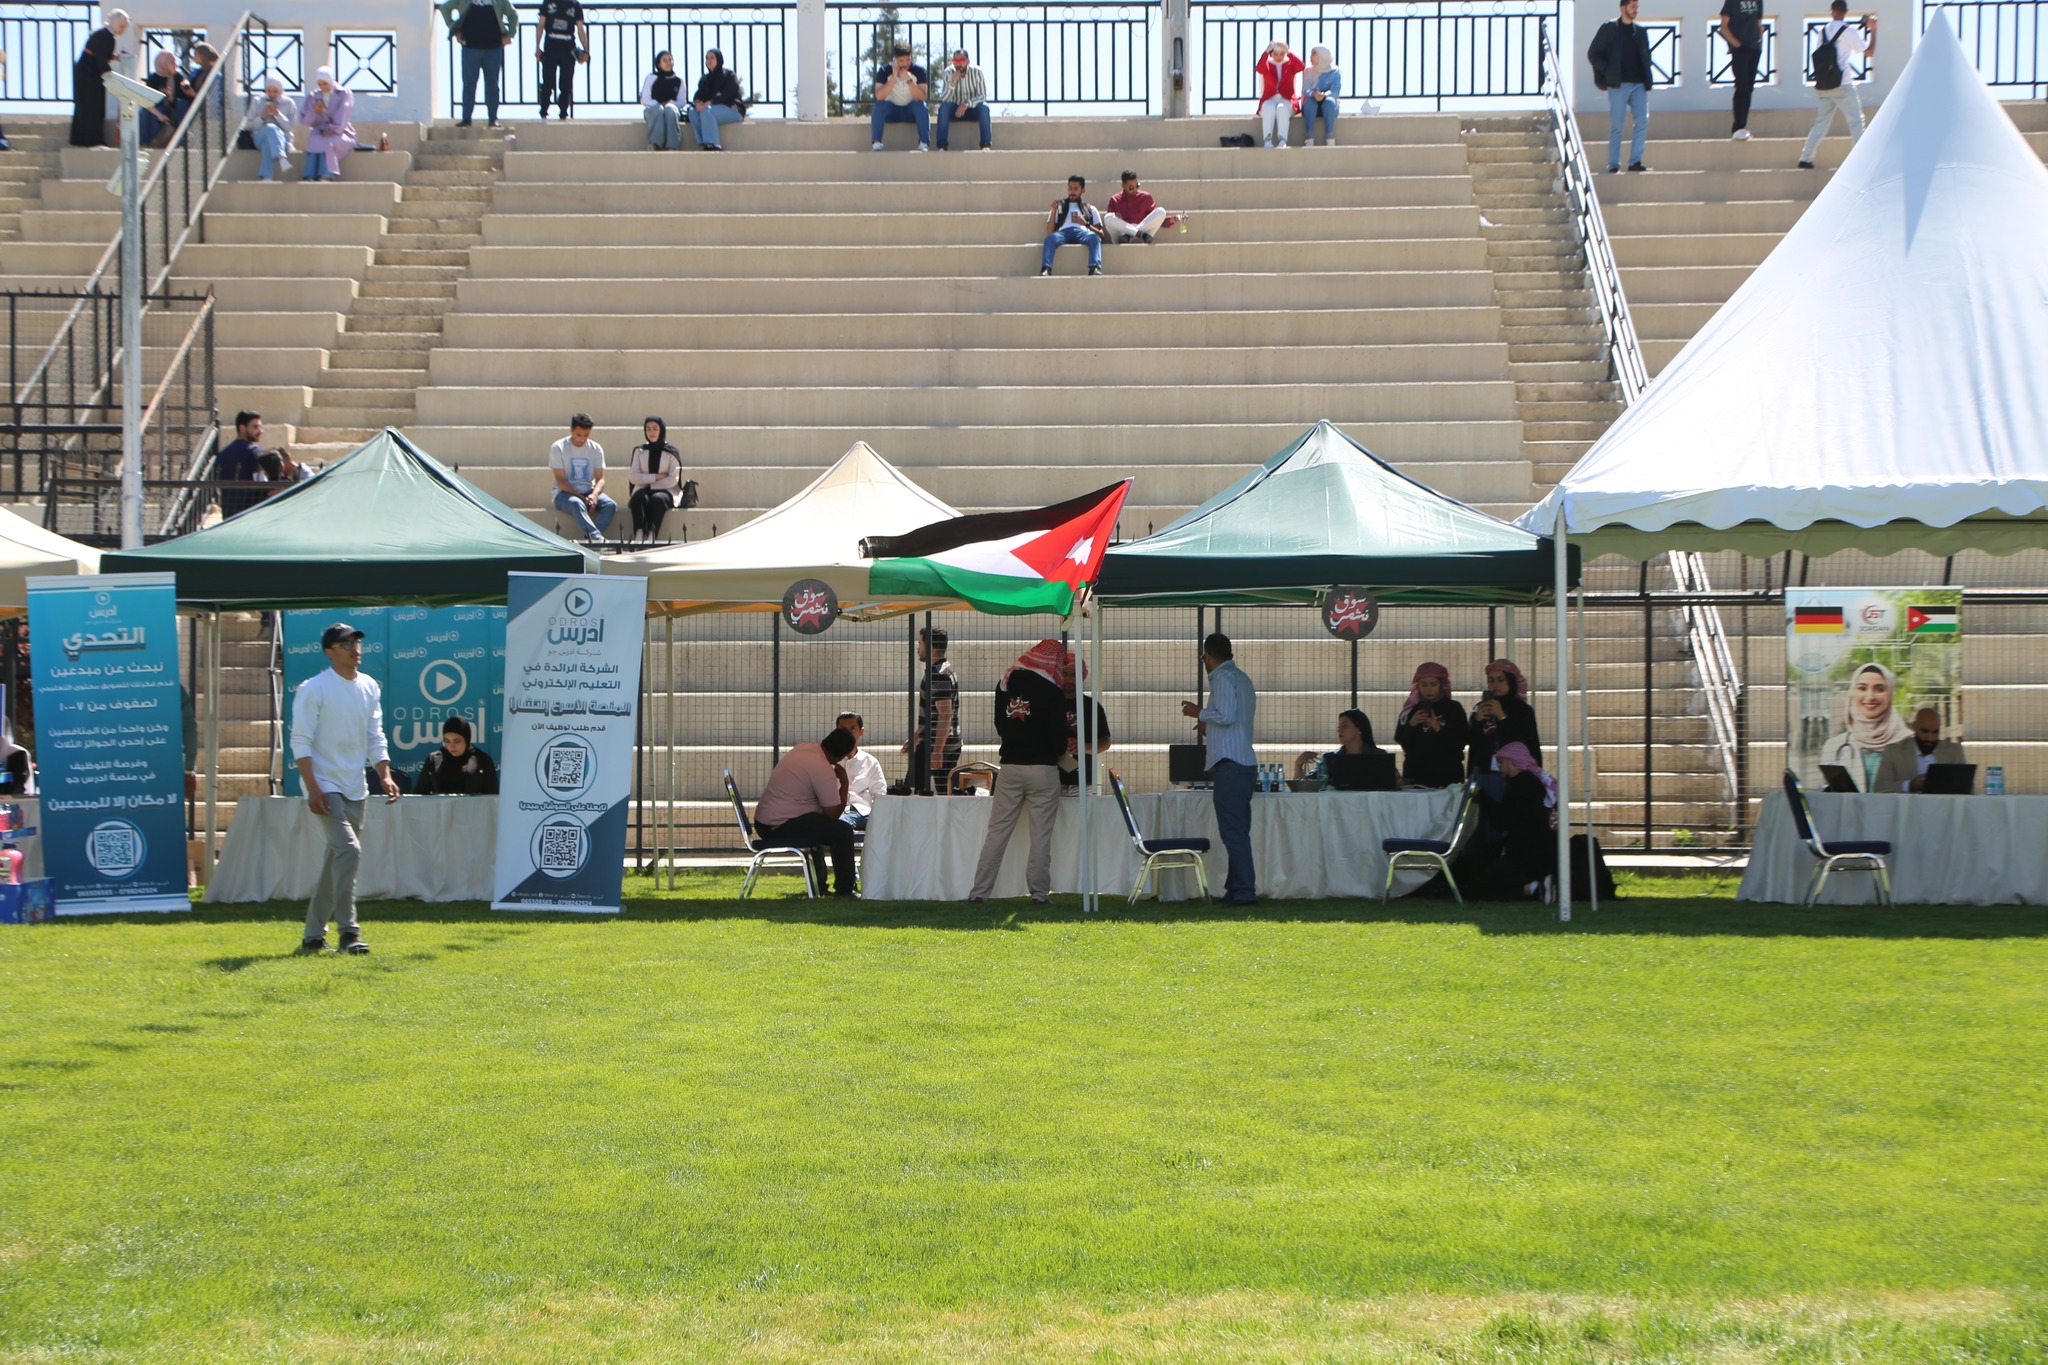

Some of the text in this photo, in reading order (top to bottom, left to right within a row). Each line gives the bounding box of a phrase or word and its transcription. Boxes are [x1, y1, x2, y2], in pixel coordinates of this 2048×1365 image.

[794, 589, 825, 609] سوق
[1334, 595, 1367, 614] سوق
[548, 616, 598, 627] ODROS
[62, 627, 146, 656] التحدي
[576, 648, 601, 657] شركة
[50, 661, 164, 678] نبحث عن مبدعين
[523, 663, 618, 675] الشركة الرائدة في
[522, 679, 621, 691] التعليم الإلكتروني
[87, 701, 107, 712] من
[109, 698, 158, 710] لصفوف
[588, 700, 632, 717] المنصة
[393, 706, 475, 720] ODROS
[48, 727, 100, 737] المنافسين
[101, 726, 117, 735] من
[146, 723, 169, 733] وكن
[546, 724, 570, 732] توظيف
[571, 724, 589, 732] طلب
[83, 738, 116, 749] الجوائز
[146, 737, 167, 746] على
[69, 760, 148, 771] وفرصة التوظيف
[109, 772, 138, 781] منصة
[139, 772, 156, 783] في
[48, 797, 110, 811] للمبدعين
[127, 794, 165, 808] مكان
[167, 793, 177, 804] لا
[519, 801, 608, 813] تابعنا على السوشال ميديا
